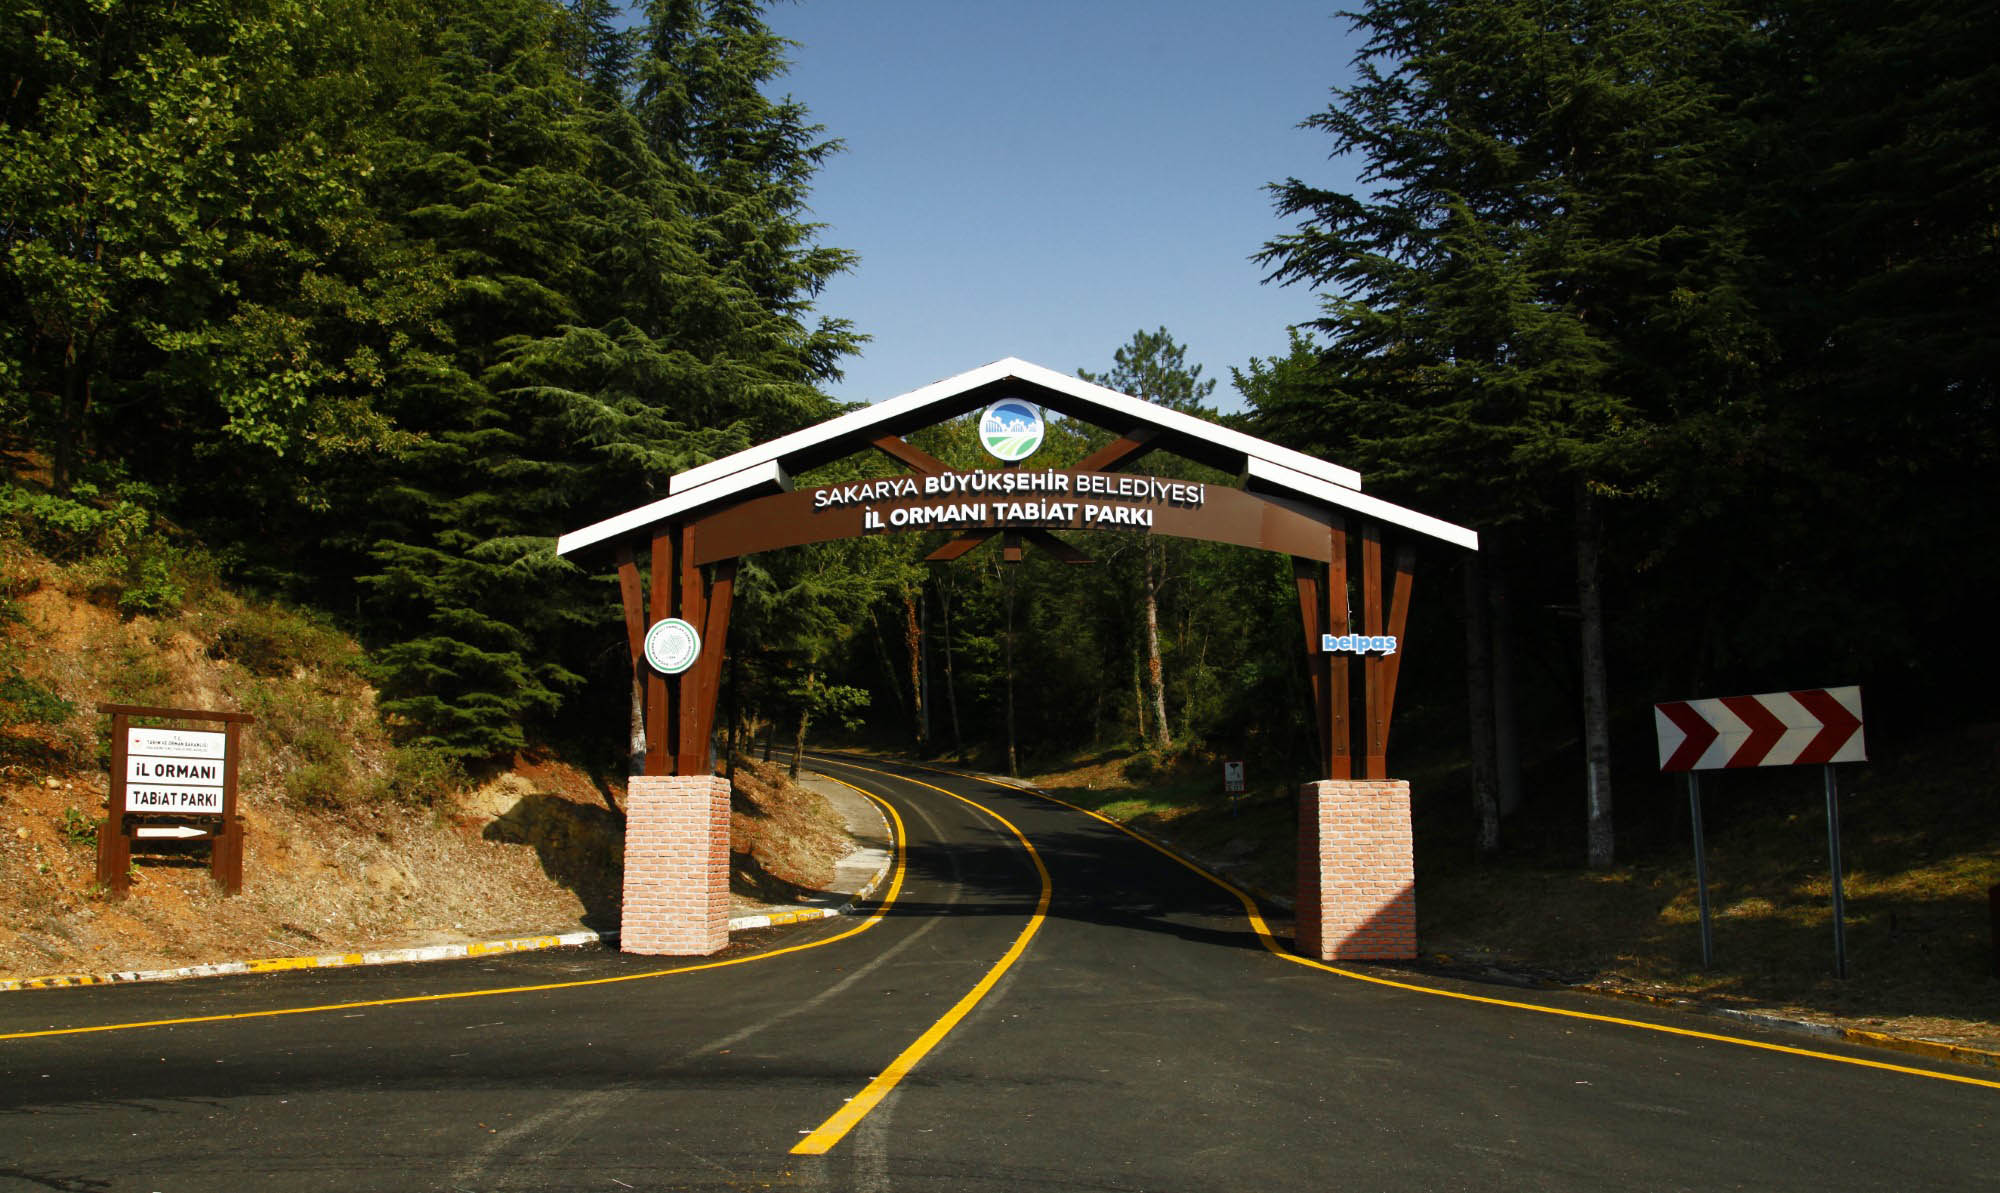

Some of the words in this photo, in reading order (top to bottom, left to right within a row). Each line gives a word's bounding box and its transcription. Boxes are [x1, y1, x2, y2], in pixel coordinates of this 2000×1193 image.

[814, 478, 919, 507] SAKARYA
[925, 468, 1069, 493] BÜYÜKŞEHİR
[1076, 475, 1205, 504] BELEDİYESİ
[865, 506, 886, 529] İL
[890, 503, 986, 527] ORMANI
[993, 498, 1079, 521] TABİAT
[1085, 504, 1153, 527] PARKI
[1322, 634, 1397, 656] belpaş
[155, 763, 216, 779] ORMANI
[181, 793, 217, 807] PARKI
